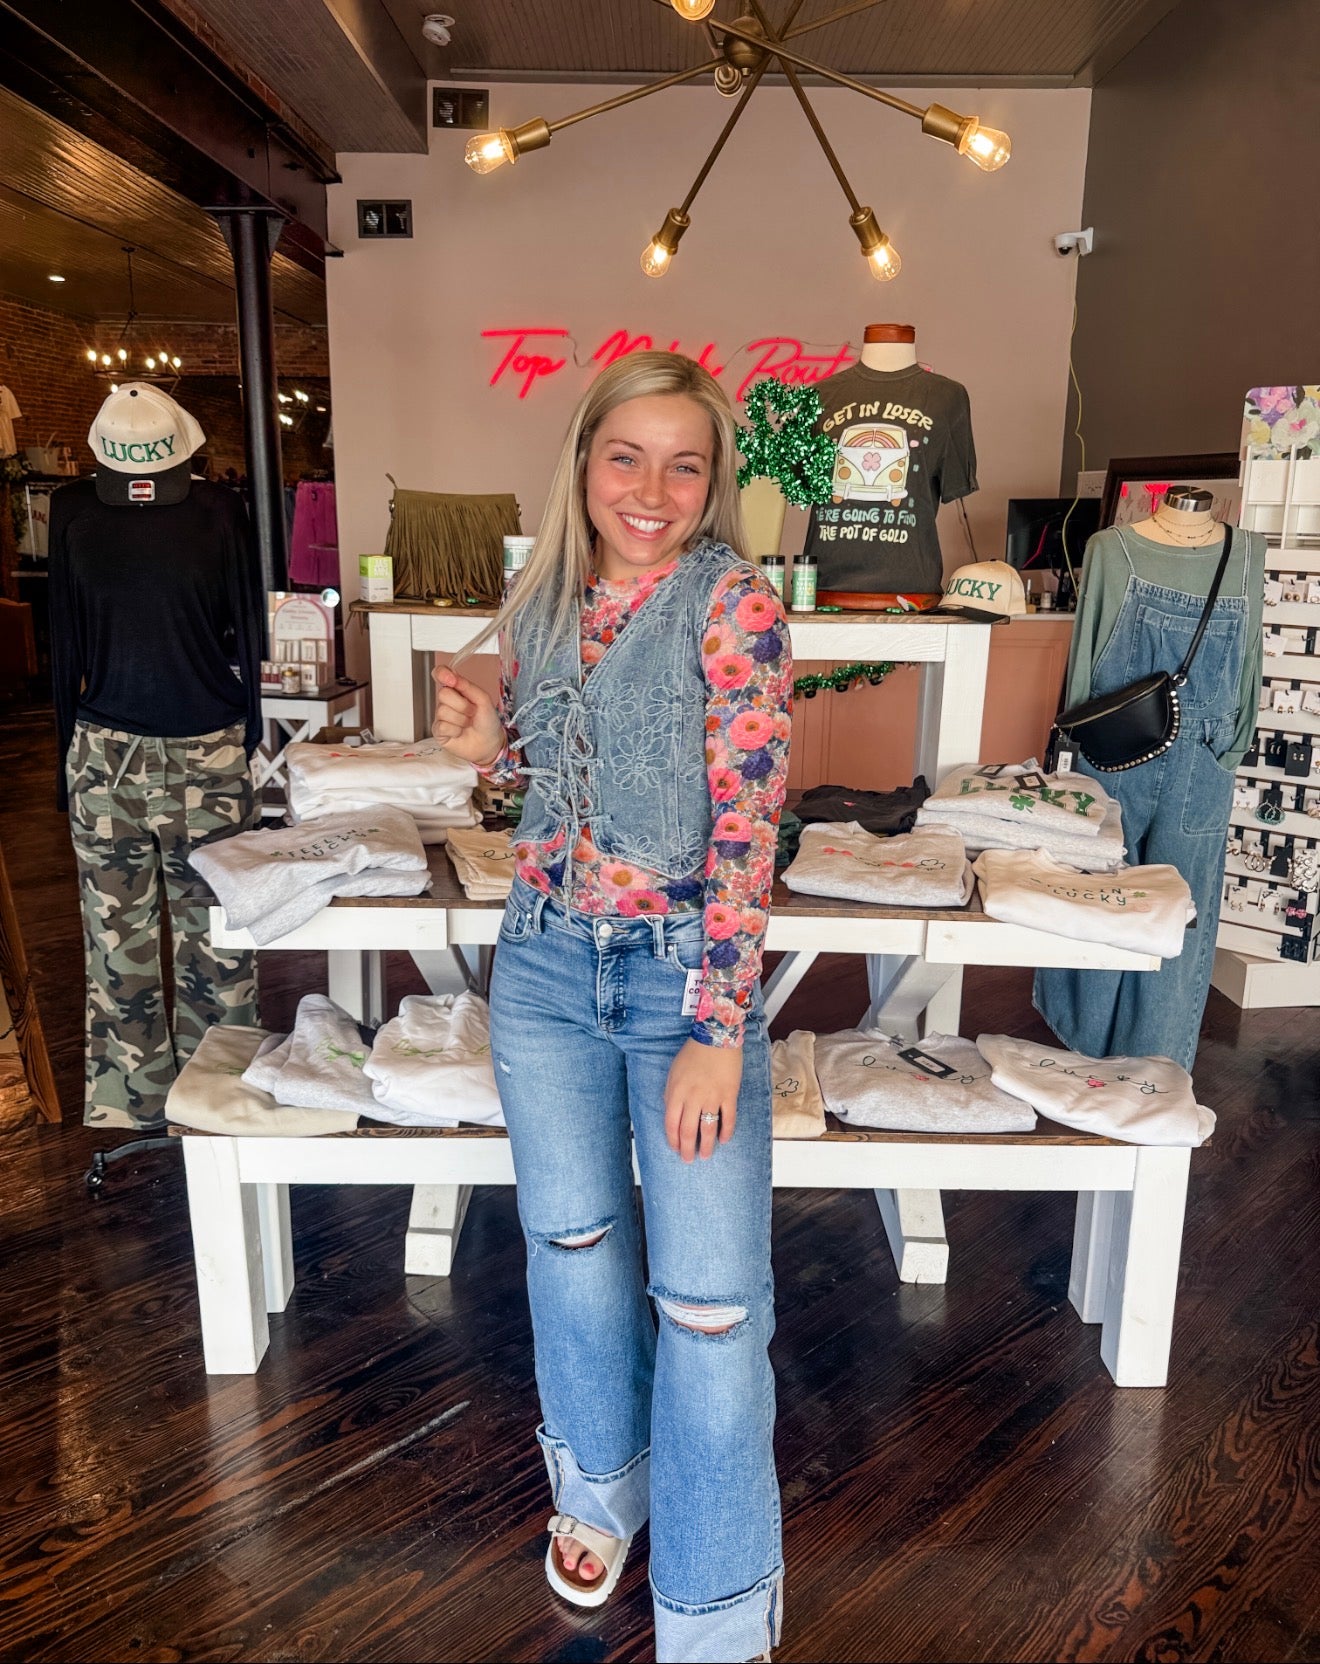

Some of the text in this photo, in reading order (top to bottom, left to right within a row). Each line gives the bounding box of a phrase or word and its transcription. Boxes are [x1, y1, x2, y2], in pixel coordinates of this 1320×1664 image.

[481, 329, 569, 399] Top
[822, 401, 934, 432] GET IN LOSER
[100, 434, 176, 463] LUCKY
[816, 507, 917, 527] E'RE GOING TO FIND
[819, 524, 908, 543] THE POT OF GOLD
[945, 578, 1002, 601] UCKY
